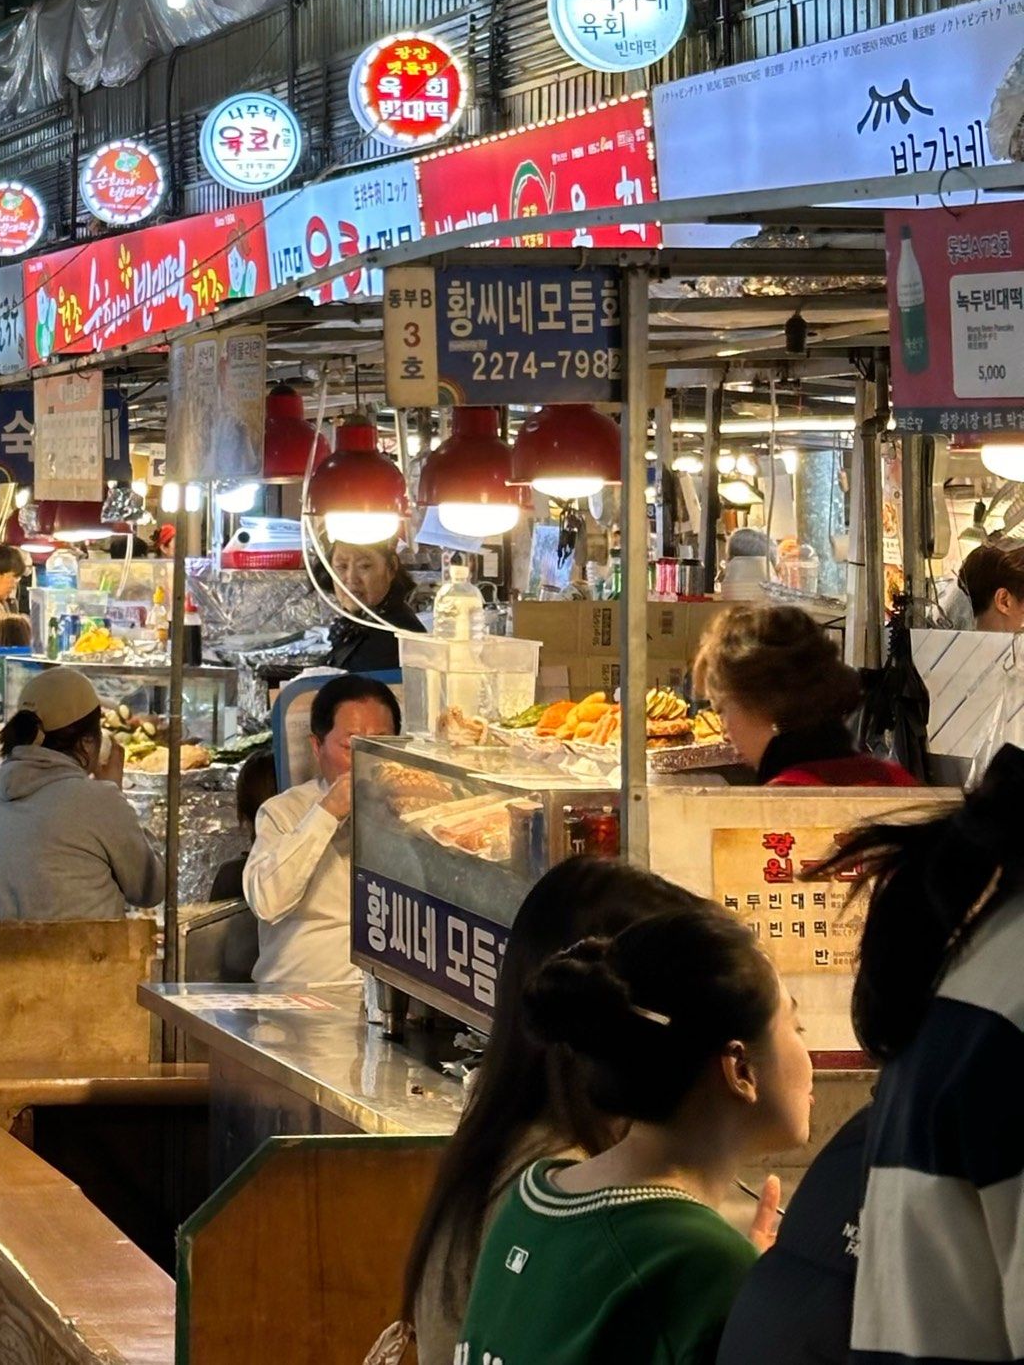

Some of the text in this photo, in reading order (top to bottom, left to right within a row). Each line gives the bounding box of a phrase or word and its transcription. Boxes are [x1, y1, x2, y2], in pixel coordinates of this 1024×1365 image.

[578, 12, 627, 40] 육회
[395, 46, 431, 60] 광장
[615, 38, 658, 56] 빈대떡
[378, 100, 449, 123] 빈대떡
[218, 125, 281, 157] 육회
[948, 231, 1013, 264] 동부A73호
[389, 290, 433, 309] 동부B
[956, 287, 1024, 313] 녹두빈대떡
[404, 322, 421, 348] 3
[400, 357, 425, 380] 호
[978, 365, 1007, 383] 5,000
[939, 412, 979, 430] 광장시장
[983, 412, 1004, 429] 대표
[367, 881, 508, 1008] 황씨네 모듬
